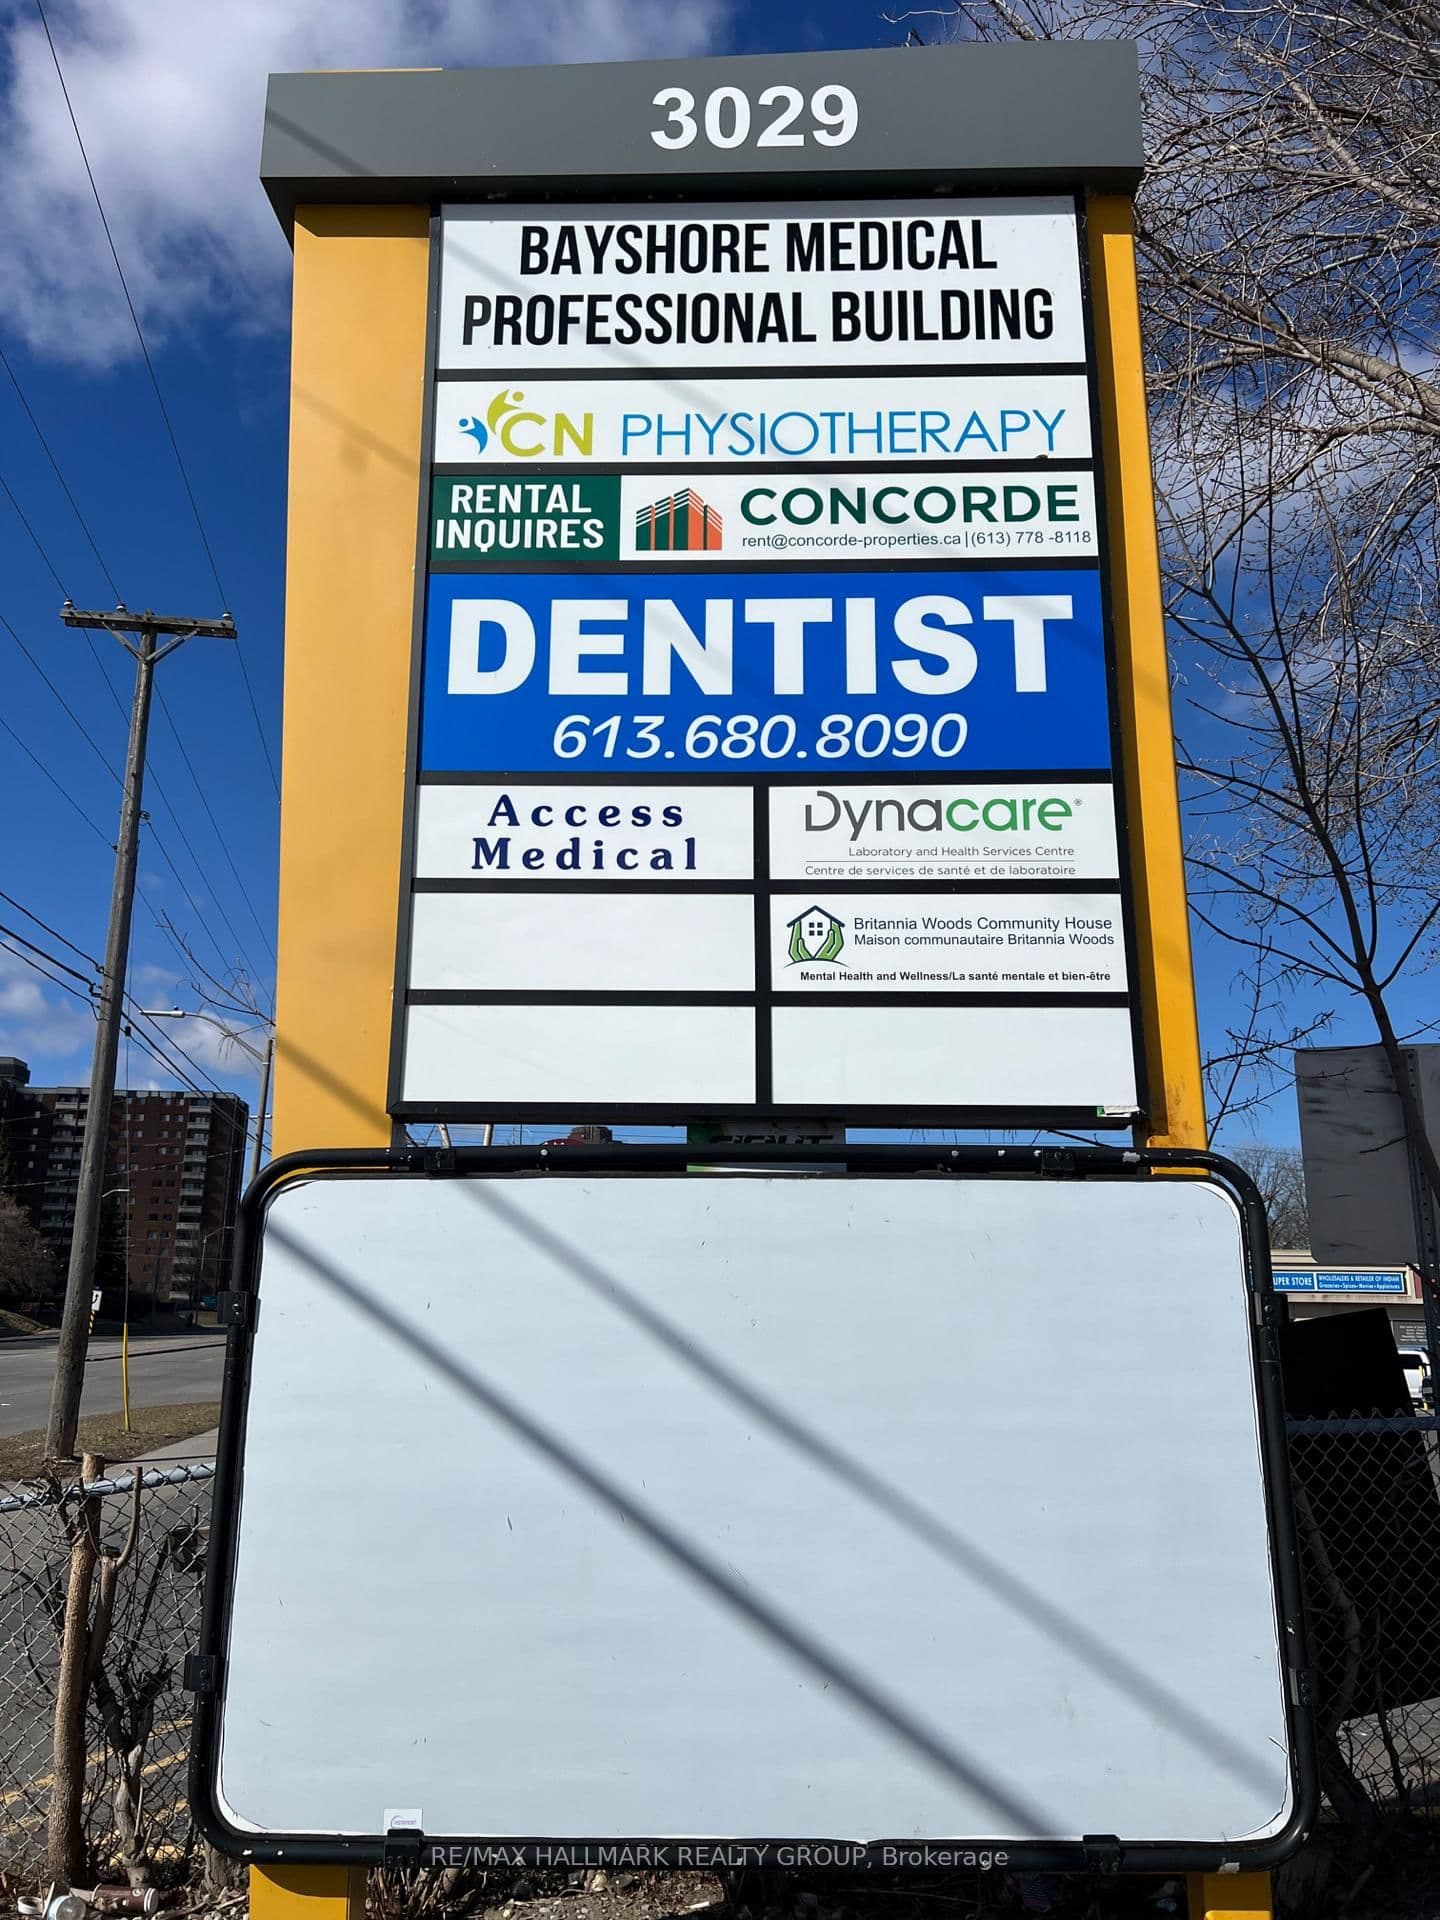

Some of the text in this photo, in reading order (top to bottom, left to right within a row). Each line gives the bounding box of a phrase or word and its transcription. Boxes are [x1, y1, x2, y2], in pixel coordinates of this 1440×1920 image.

[651, 85, 858, 149] 3029
[520, 219, 997, 275] BAYSHORE MEDICAL
[463, 288, 1053, 345] PROFESSIONAL BUILDING
[501, 408, 1066, 457] CN PHYSIOTHERAPY
[451, 484, 591, 513] RENTAL
[741, 485, 1079, 525] CONCORDE
[436, 519, 603, 552] INQUIRES
[743, 533, 960, 549] rent@concorde-properties.ca
[972, 532, 1010, 547] (613)
[1015, 530, 1044, 544] 778
[1048, 530, 1092, 544] -8118
[448, 595, 1073, 695] DENTIST
[554, 713, 967, 758] 613.680.8090
[487, 794, 682, 827] Access
[472, 837, 696, 870] Medical
[848, 846, 1075, 858] Laboratory and Health Services Centre
[804, 864, 1076, 877] Centre de services de santé et de laboratoire
[854, 916, 1113, 933] Britannia Woods Community House
[854, 933, 1115, 946] Maison communautaire Britannia Woods
[800, 971, 1111, 981] Mental Health and Wellness/La santé mentale et bien-être
[1292, 1276, 1312, 1286] STORE
